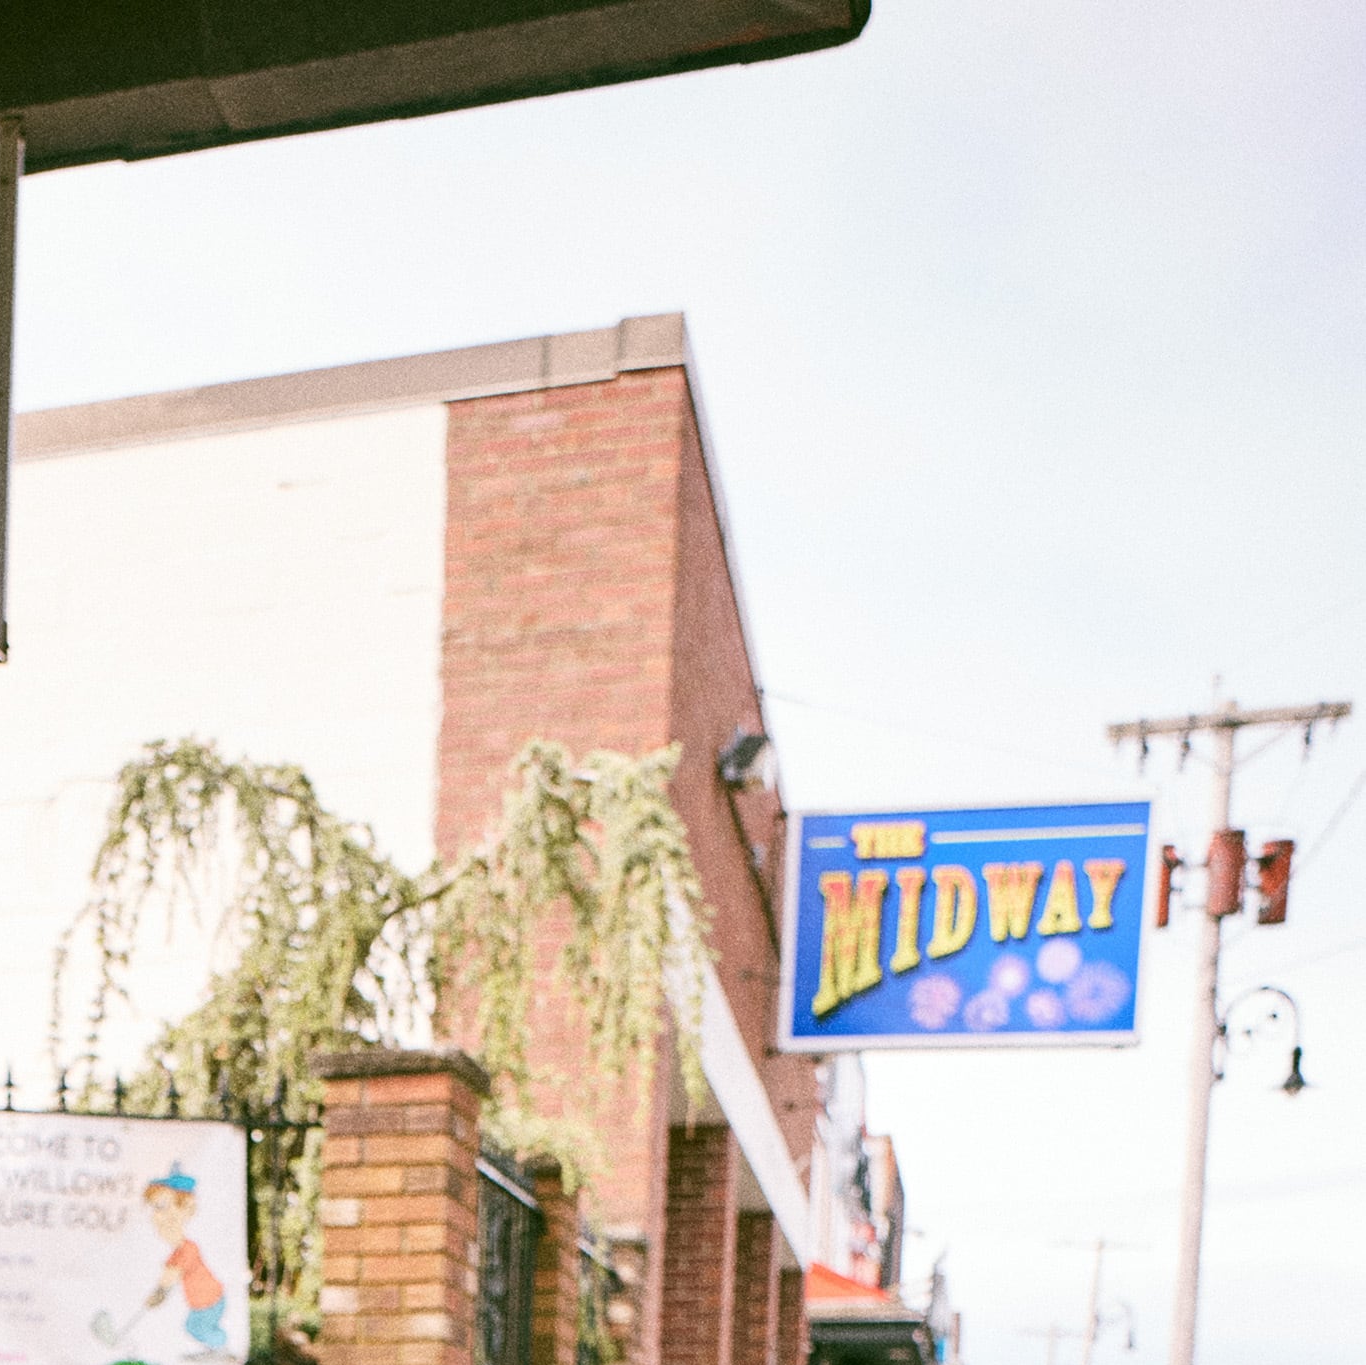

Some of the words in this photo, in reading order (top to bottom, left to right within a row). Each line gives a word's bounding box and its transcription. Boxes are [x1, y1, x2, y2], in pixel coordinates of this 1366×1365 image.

[851, 820, 926, 860] THE
[811, 858, 1127, 1018] MIDWAY
[84, 1136, 122, 1163] TO
